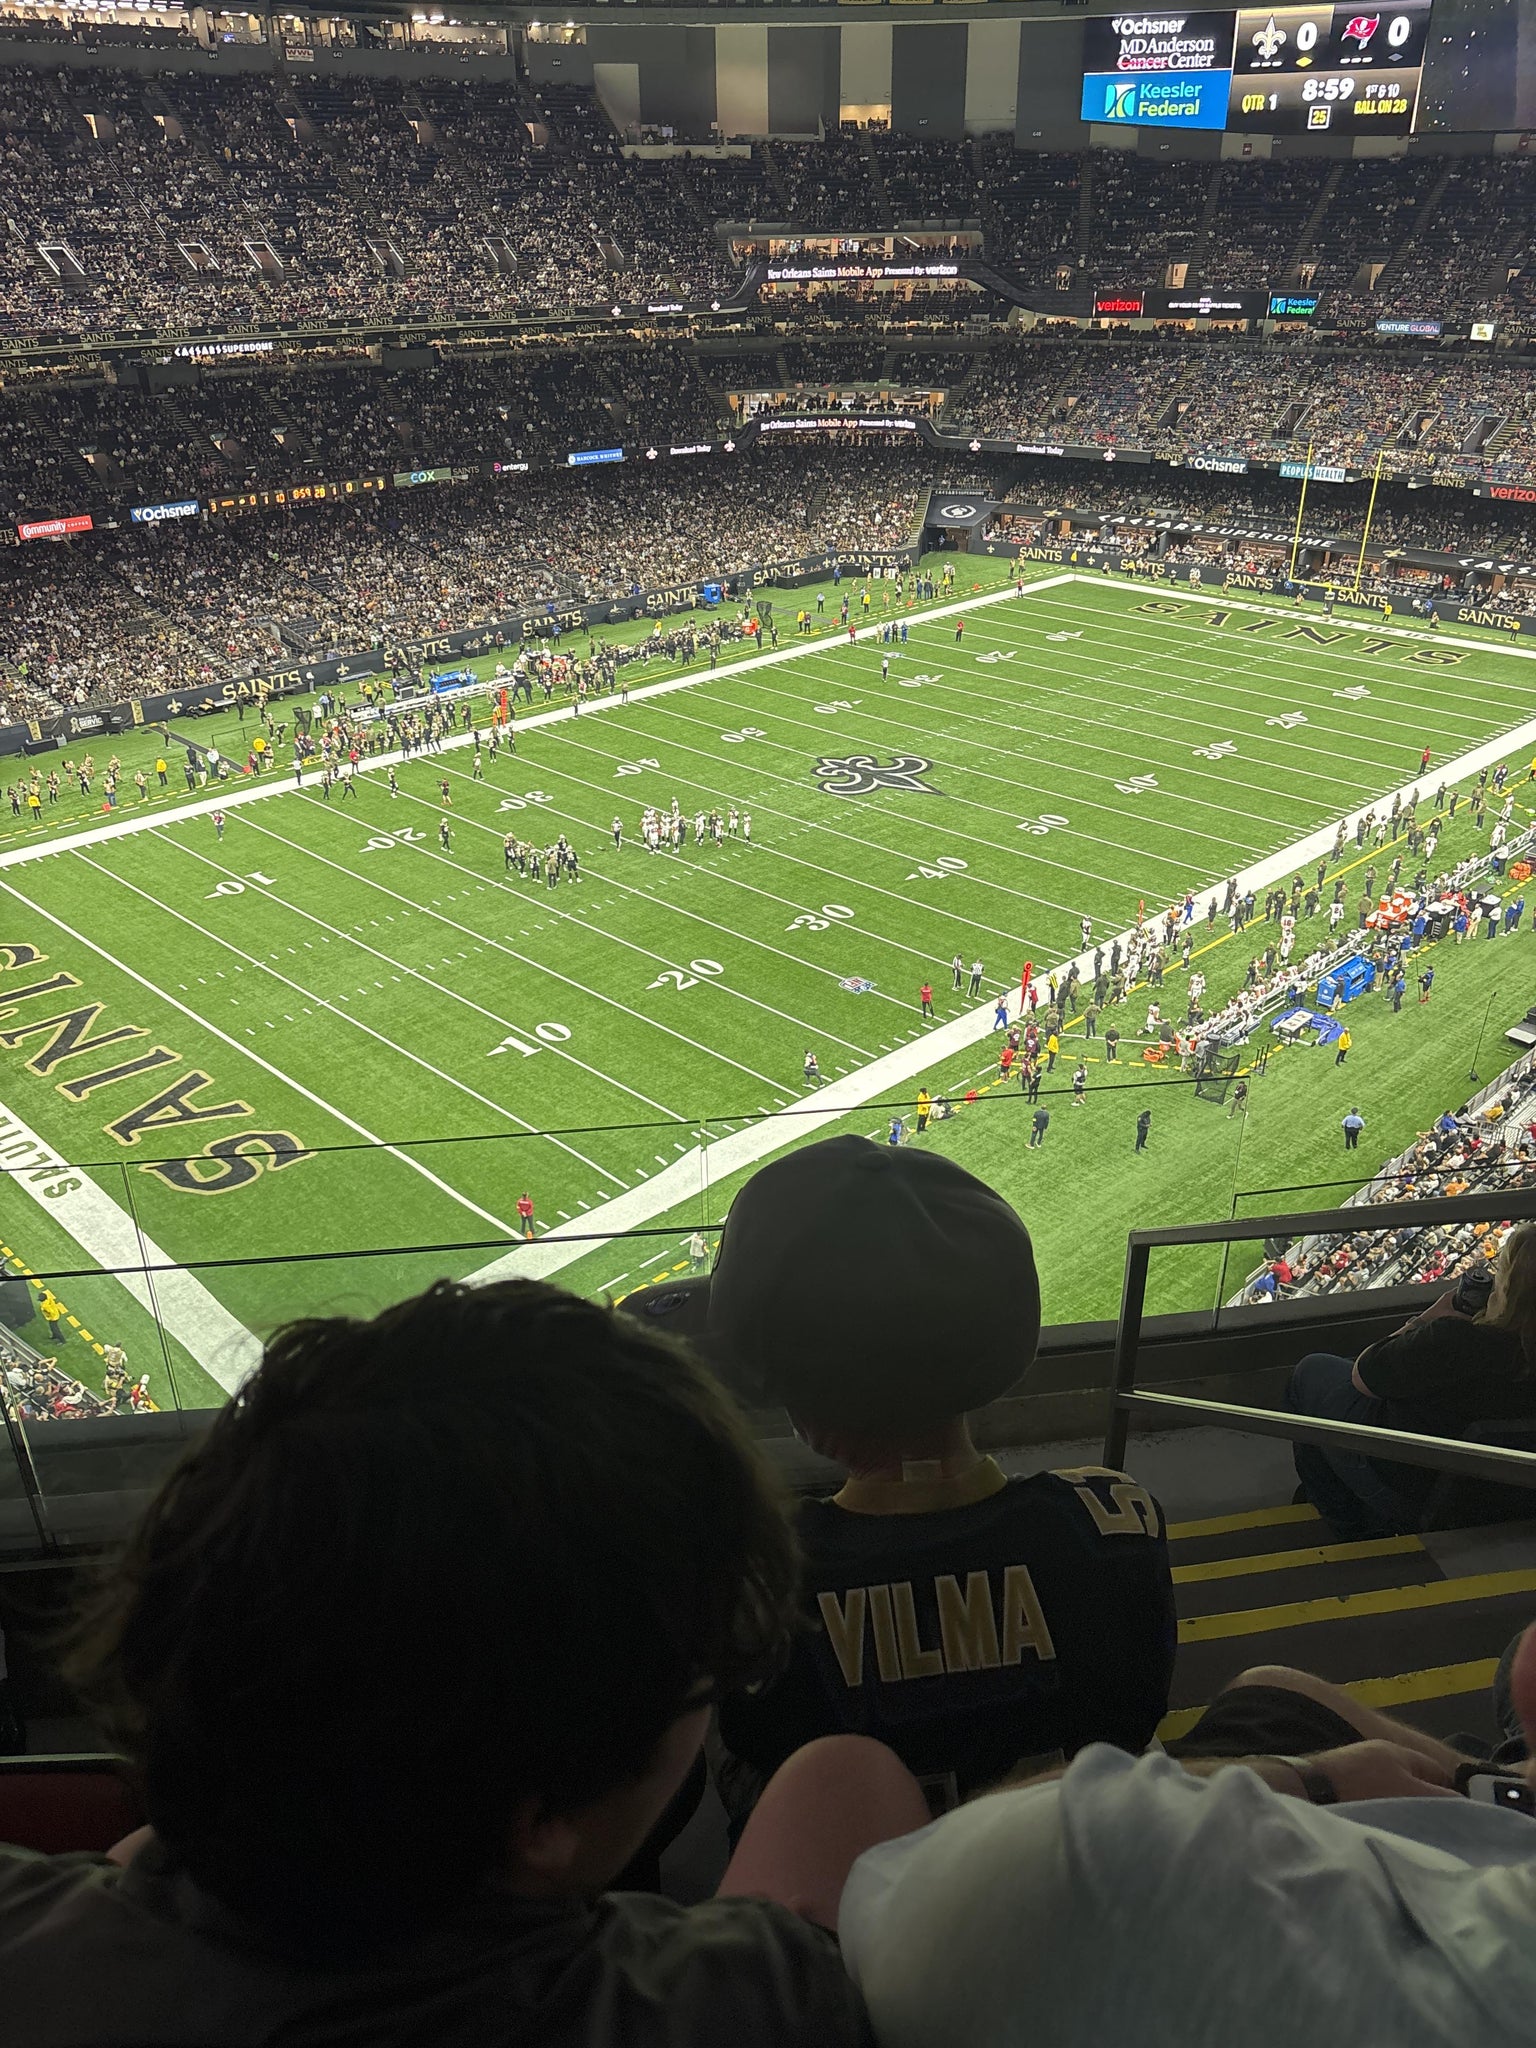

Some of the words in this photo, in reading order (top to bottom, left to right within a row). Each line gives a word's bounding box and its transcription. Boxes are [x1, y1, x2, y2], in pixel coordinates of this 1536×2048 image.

[1121, 18, 1185, 35] Ochsner
[1387, 16, 1410, 46] 0
[1296, 21, 1318, 51] 0
[1119, 38, 1147, 54] MD
[1146, 37, 1215, 54] Anderson
[1117, 54, 1168, 70] Cancer
[1168, 53, 1215, 68] Center
[1140, 82, 1203, 100] Keesler
[1302, 78, 1355, 101] 8:59
[1387, 83, 1400, 98] 10
[1139, 99, 1200, 116] Federal
[1242, 94, 1265, 113] QTR
[1269, 94, 1278, 110] 1
[1354, 100, 1377, 115] BALL
[1377, 100, 1392, 114] ON
[1392, 98, 1407, 114] 28
[1312, 110, 1327, 124] 25
[768, 269, 781, 279] New
[782, 268, 811, 279] Orleans
[812, 267, 837, 278] Saints
[837, 266, 865, 276] Mobile
[865, 266, 883, 278] App
[926, 264, 957, 275] verizon
[1097, 298, 1140, 312] verizon
[1288, 298, 1316, 306] Keesler
[488, 311, 516, 320] SAINTS
[549, 308, 576, 317] SAINTS
[1287, 306, 1315, 314] Federal
[363, 316, 393, 326] SAINTS
[427, 313, 456, 322] SAINTS
[688, 318, 712, 327] SAINTS
[746, 316, 772, 324] SAINTS
[804, 315, 831, 323] SAINTS
[865, 314, 891, 322] SAINTS
[924, 314, 950, 322] SAINTS
[1336, 319, 1367, 328] SAINTS
[227, 325, 260, 334] SAINTS
[297, 321, 328, 330] SAINTS
[519, 326, 545, 334] SAINTS
[576, 324, 601, 332] SAINTS
[1376, 323, 1410, 332] VENTURE
[1410, 324, 1439, 333] GLOBAL
[80, 332, 116, 343] SAINTS
[156, 328, 190, 339] SAINTS
[336, 336, 364, 345] SAINTS
[399, 333, 426, 342] SAINTS
[459, 330, 485, 338] SAINTS
[2, 337, 39, 350] SAINTS
[174, 344, 222, 357] CAESARS
[222, 342, 273, 354] SUPERDOME
[68, 353, 101, 364] SAINTS
[141, 349, 173, 358] SAINTS
[769, 420, 795, 430] Orleans
[795, 419, 817, 428] Saints
[817, 418, 842, 427] Mobile
[842, 418, 858, 429] App
[1017, 444, 1045, 454] Download
[1046, 446, 1064, 456] Today
[1155, 451, 1183, 462] SAINTS
[453, 466, 479, 475] SAINTS
[502, 463, 528, 471] entergy
[1194, 457, 1246, 474] Ochsner
[410, 471, 435, 483] COX
[1314, 467, 1344, 481] HEALTH
[1432, 476, 1465, 488] SAINTS
[211, 502, 217, 512] 3
[292, 488, 311, 499] 8:59
[314, 488, 325, 498] 28
[377, 480, 384, 490] 3
[1490, 486, 1536, 502] verizo
[143, 503, 197, 521] Ochsner
[22, 521, 66, 538] Community
[1098, 513, 1202, 534] CAESARS
[1206, 526, 1336, 548] SUPERDOME
[1018, 547, 1062, 561] SAINTS
[1337, 590, 1388, 608] SAINTS
[1458, 608, 1515, 629] SAINTS
[1046, 630, 1080, 642] 10
[1128, 601, 1472, 666] SAINTS
[975, 651, 1010, 663] 20
[898, 674, 935, 688] 30
[1333, 687, 1371, 700] 10
[814, 699, 853, 714] 40
[1265, 714, 1308, 729] 20
[721, 727, 767, 743] 50
[1192, 743, 1238, 760] 30
[617, 758, 661, 775] 40
[1114, 776, 1158, 794] 40
[500, 790, 554, 810] 30
[1016, 814, 1070, 835] 50
[367, 827, 426, 849] 20
[916, 856, 968, 879] 40
[215, 871, 276, 895] 10
[793, 904, 855, 931] 30
[658, 959, 724, 991] 20
[500, 1022, 572, 1057] 10
[817, 1564, 1057, 1687] VILMA
